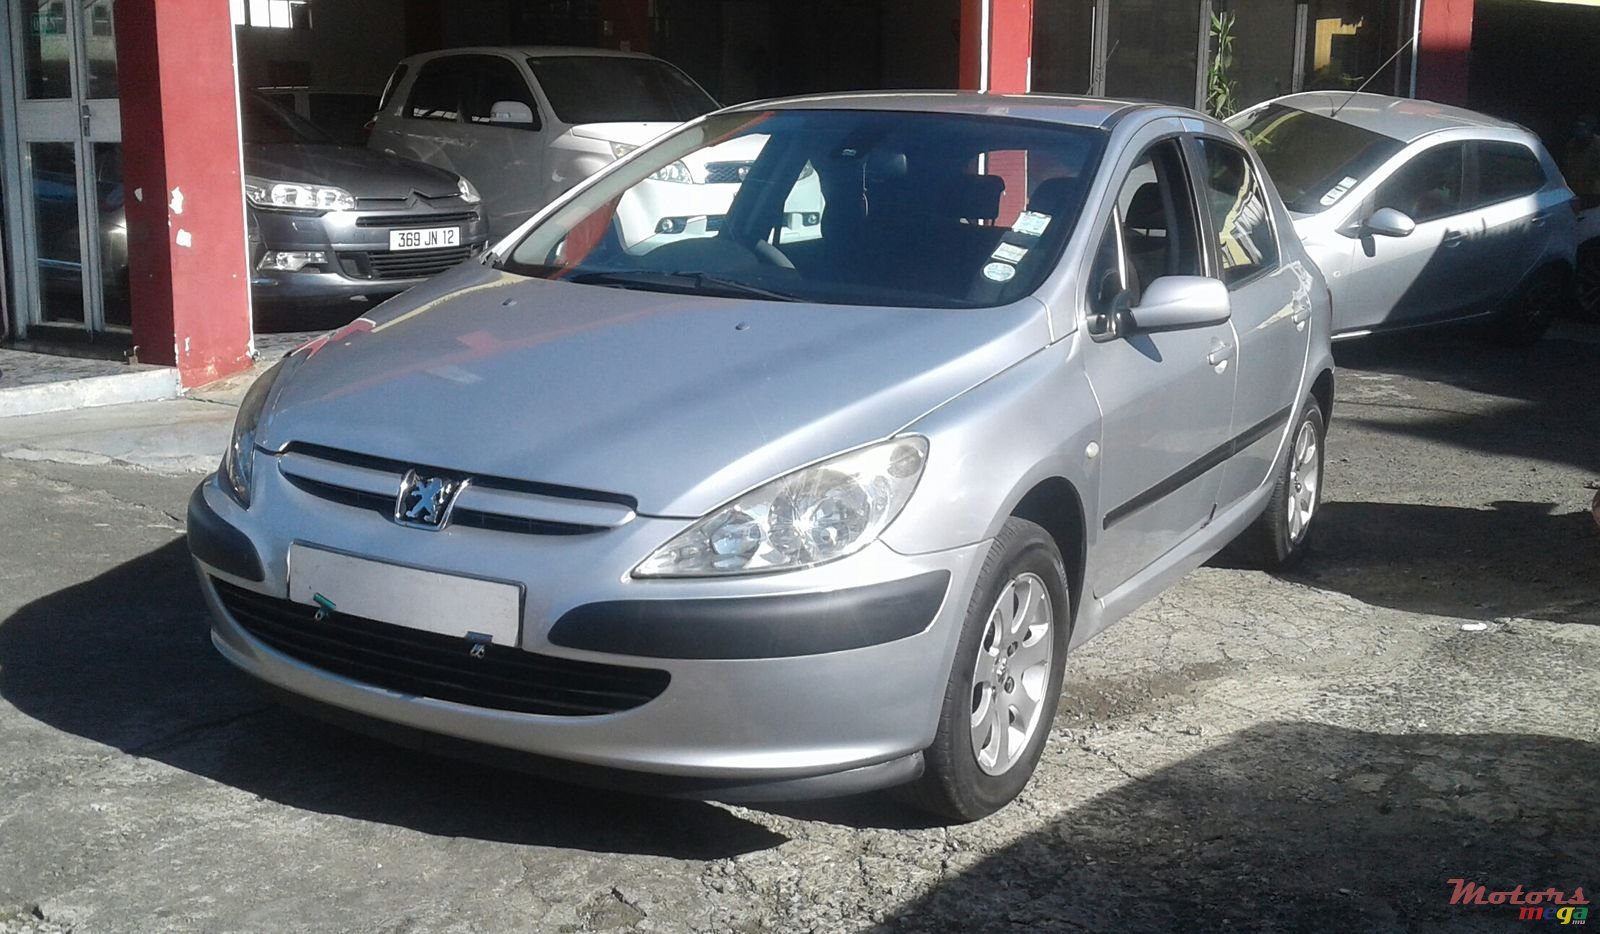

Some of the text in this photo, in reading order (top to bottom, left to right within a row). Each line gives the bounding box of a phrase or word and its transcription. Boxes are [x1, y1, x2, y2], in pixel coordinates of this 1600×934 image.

[398, 230, 455, 248] 369 JN 12
